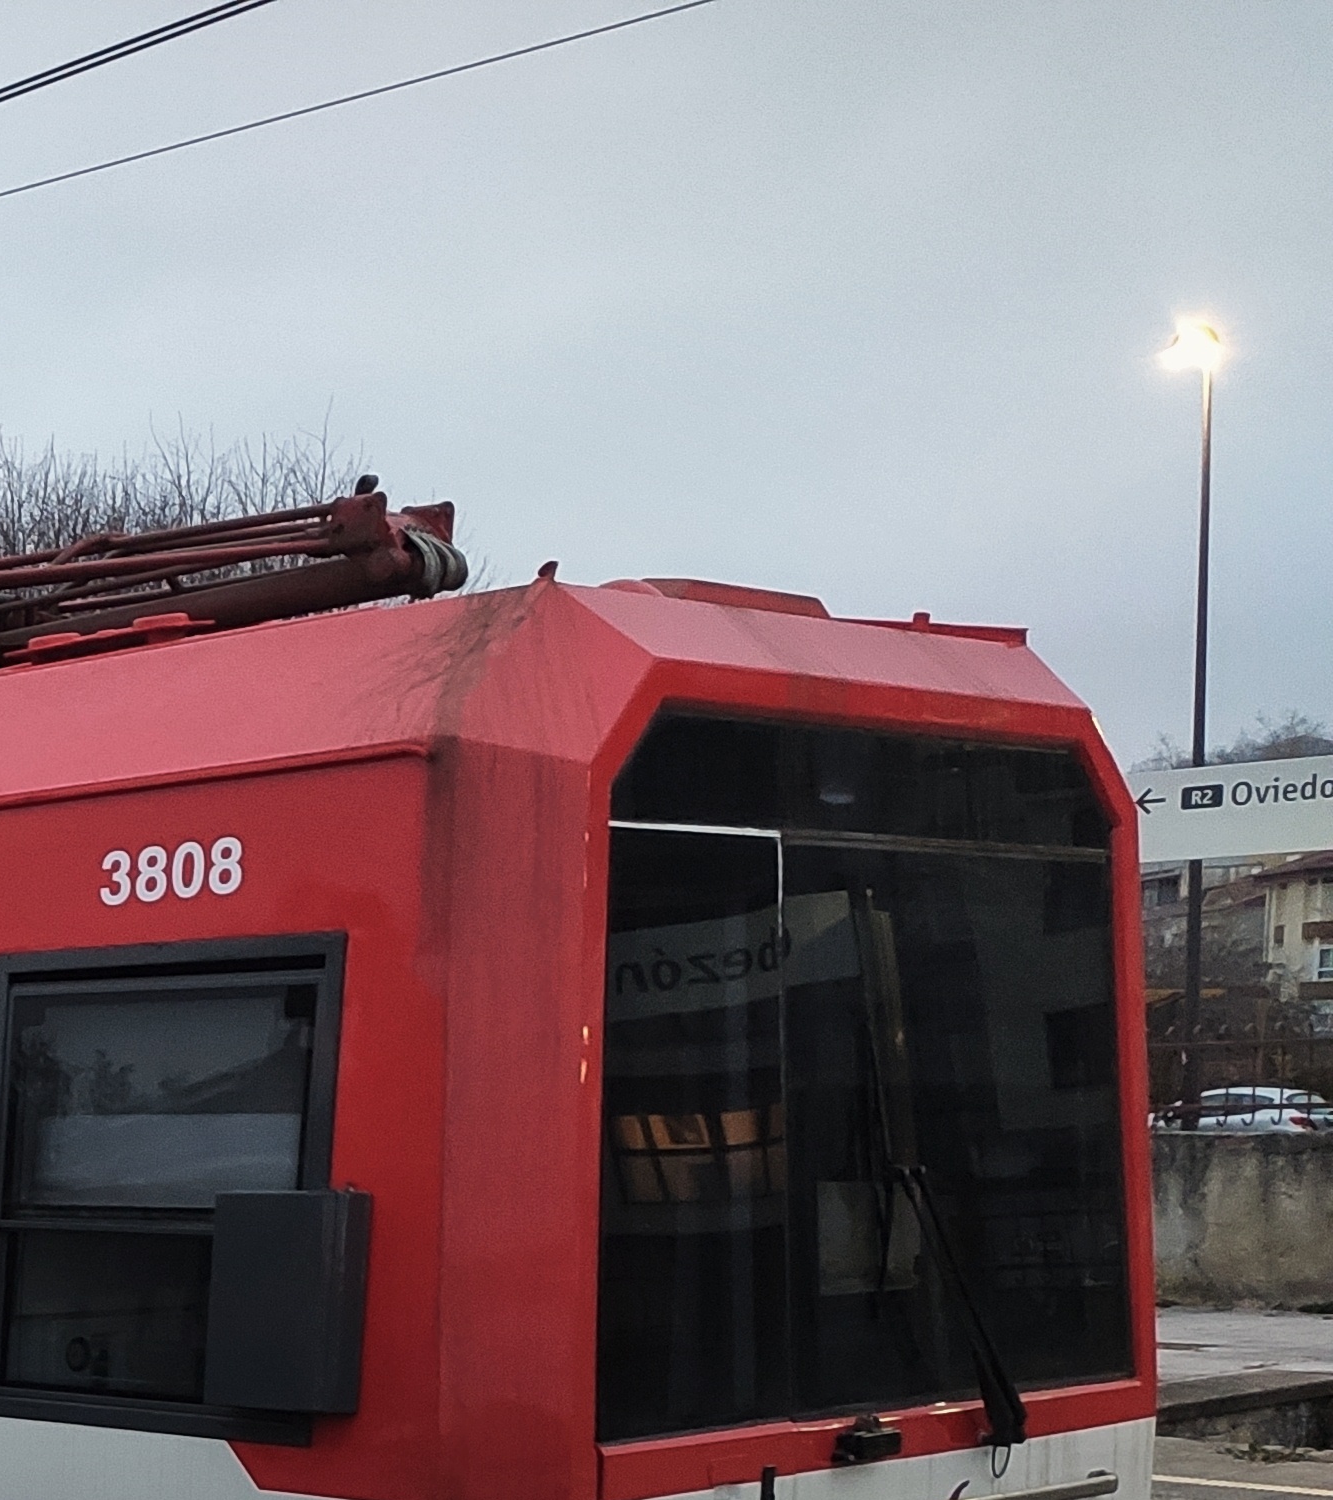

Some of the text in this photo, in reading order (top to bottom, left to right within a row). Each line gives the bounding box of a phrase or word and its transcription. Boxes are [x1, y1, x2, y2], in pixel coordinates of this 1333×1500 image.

[1191, 773, 1333, 807] R2 Oviedo
[100, 837, 243, 906] 3808
